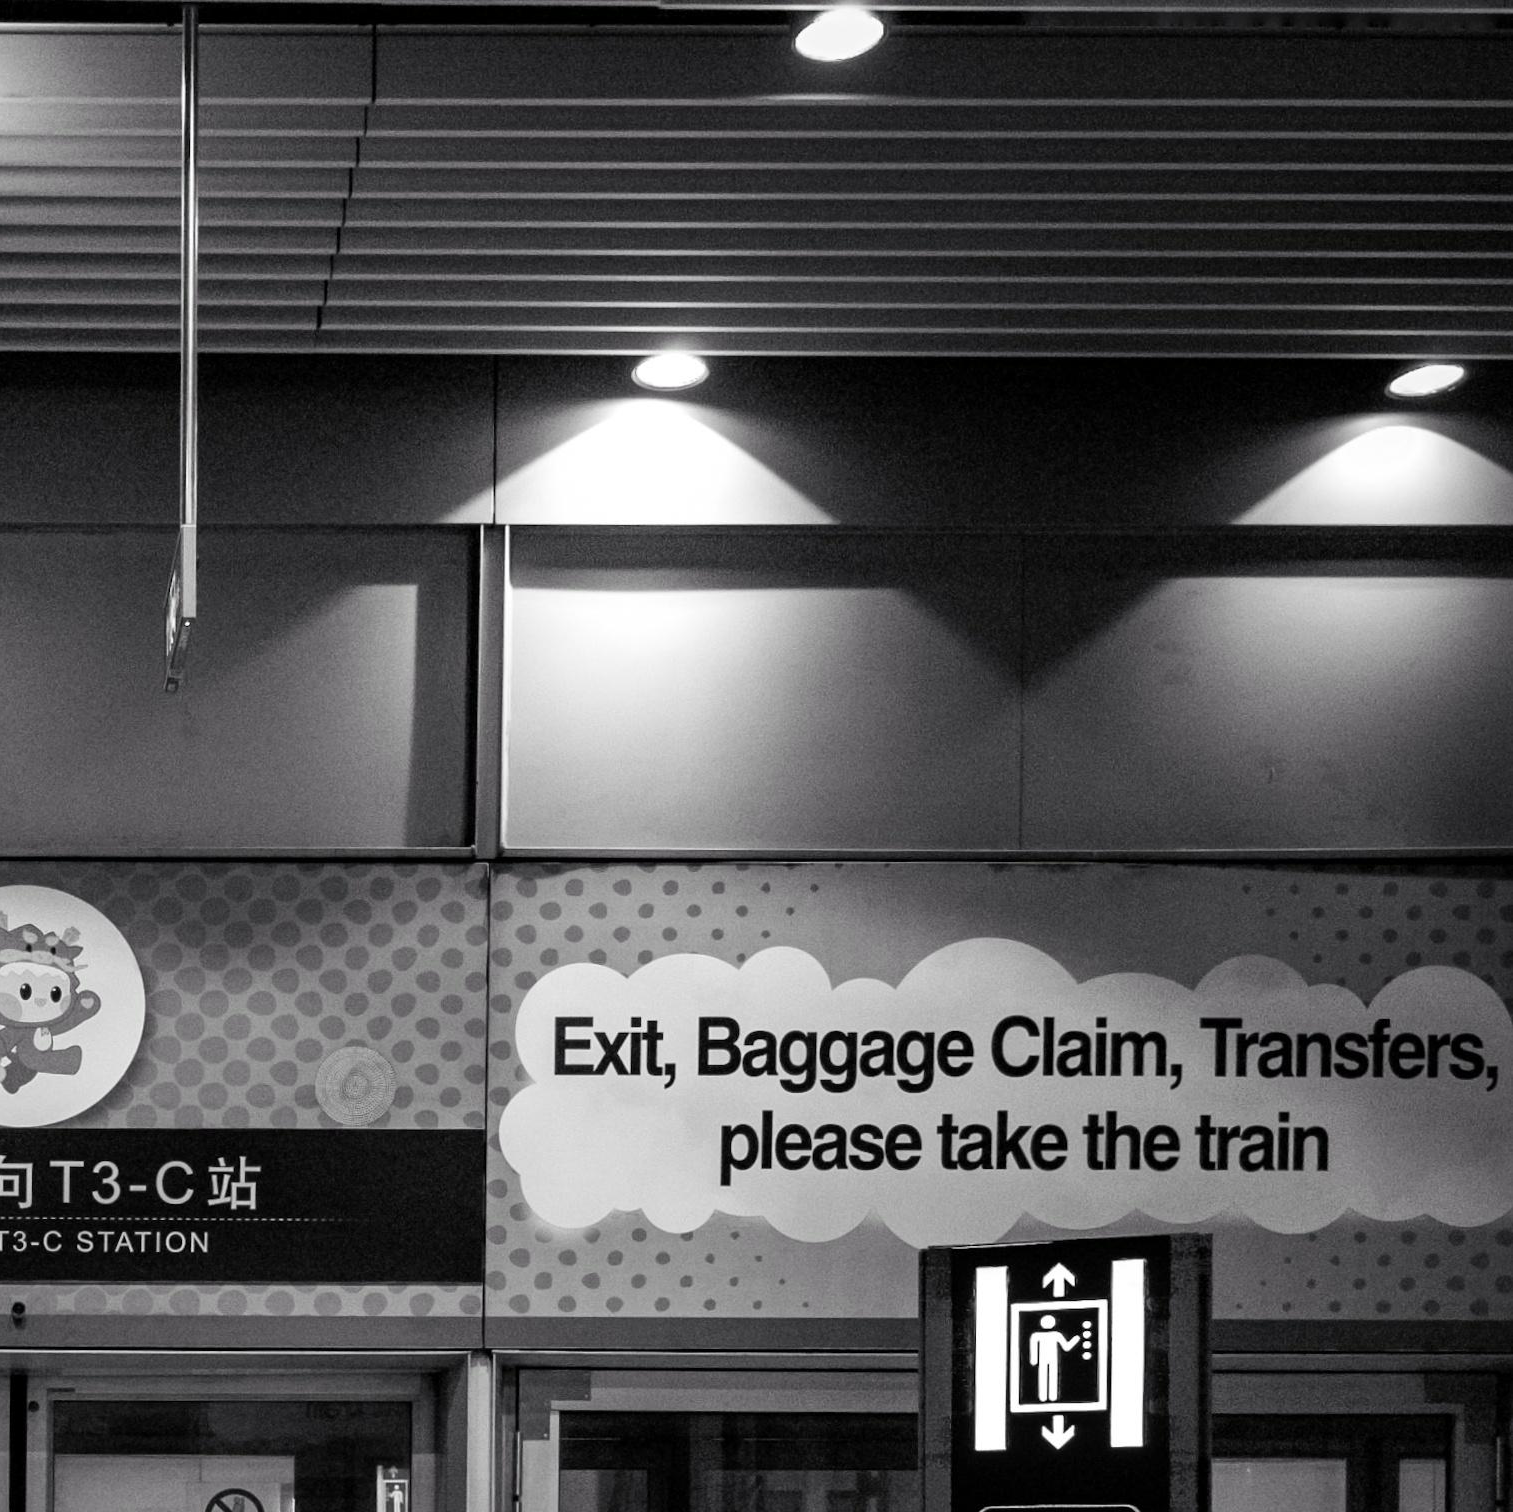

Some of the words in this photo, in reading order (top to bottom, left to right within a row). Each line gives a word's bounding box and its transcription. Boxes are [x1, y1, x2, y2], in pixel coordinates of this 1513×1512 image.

[553, 1015, 677, 1089] Exit,
[697, 1015, 975, 1094] Baggage
[990, 1014, 1184, 1090] Claim,
[1200, 1017, 1499, 1091] Transfers,
[719, 1110, 923, 1187] please
[935, 1110, 1069, 1172] take
[1081, 1110, 1182, 1172] the
[1193, 1111, 1330, 1173] train
[76, 1230, 211, 1254] STATION
